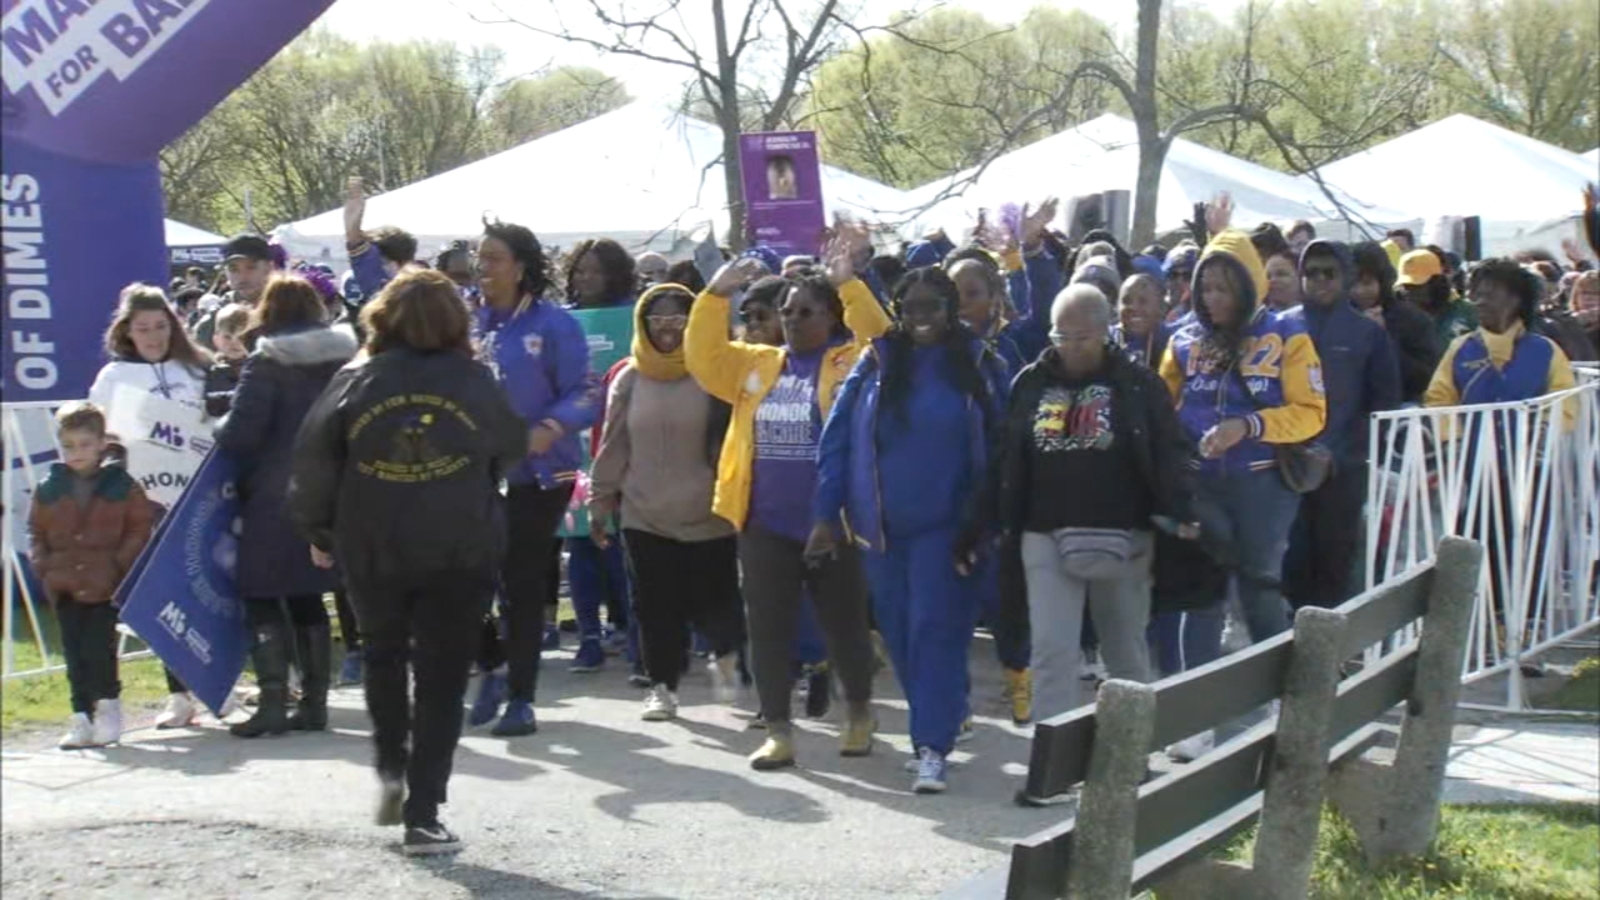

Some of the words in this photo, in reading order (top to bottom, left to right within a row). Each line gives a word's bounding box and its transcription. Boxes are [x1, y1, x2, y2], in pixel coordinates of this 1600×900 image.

[3, 0, 97, 67] MA
[45, 45, 98, 98] FOR
[100, 0, 198, 59] BA
[2, 173, 51, 319] DIMES
[14, 330, 58, 390] OF
[756, 402, 811, 422] HONOR
